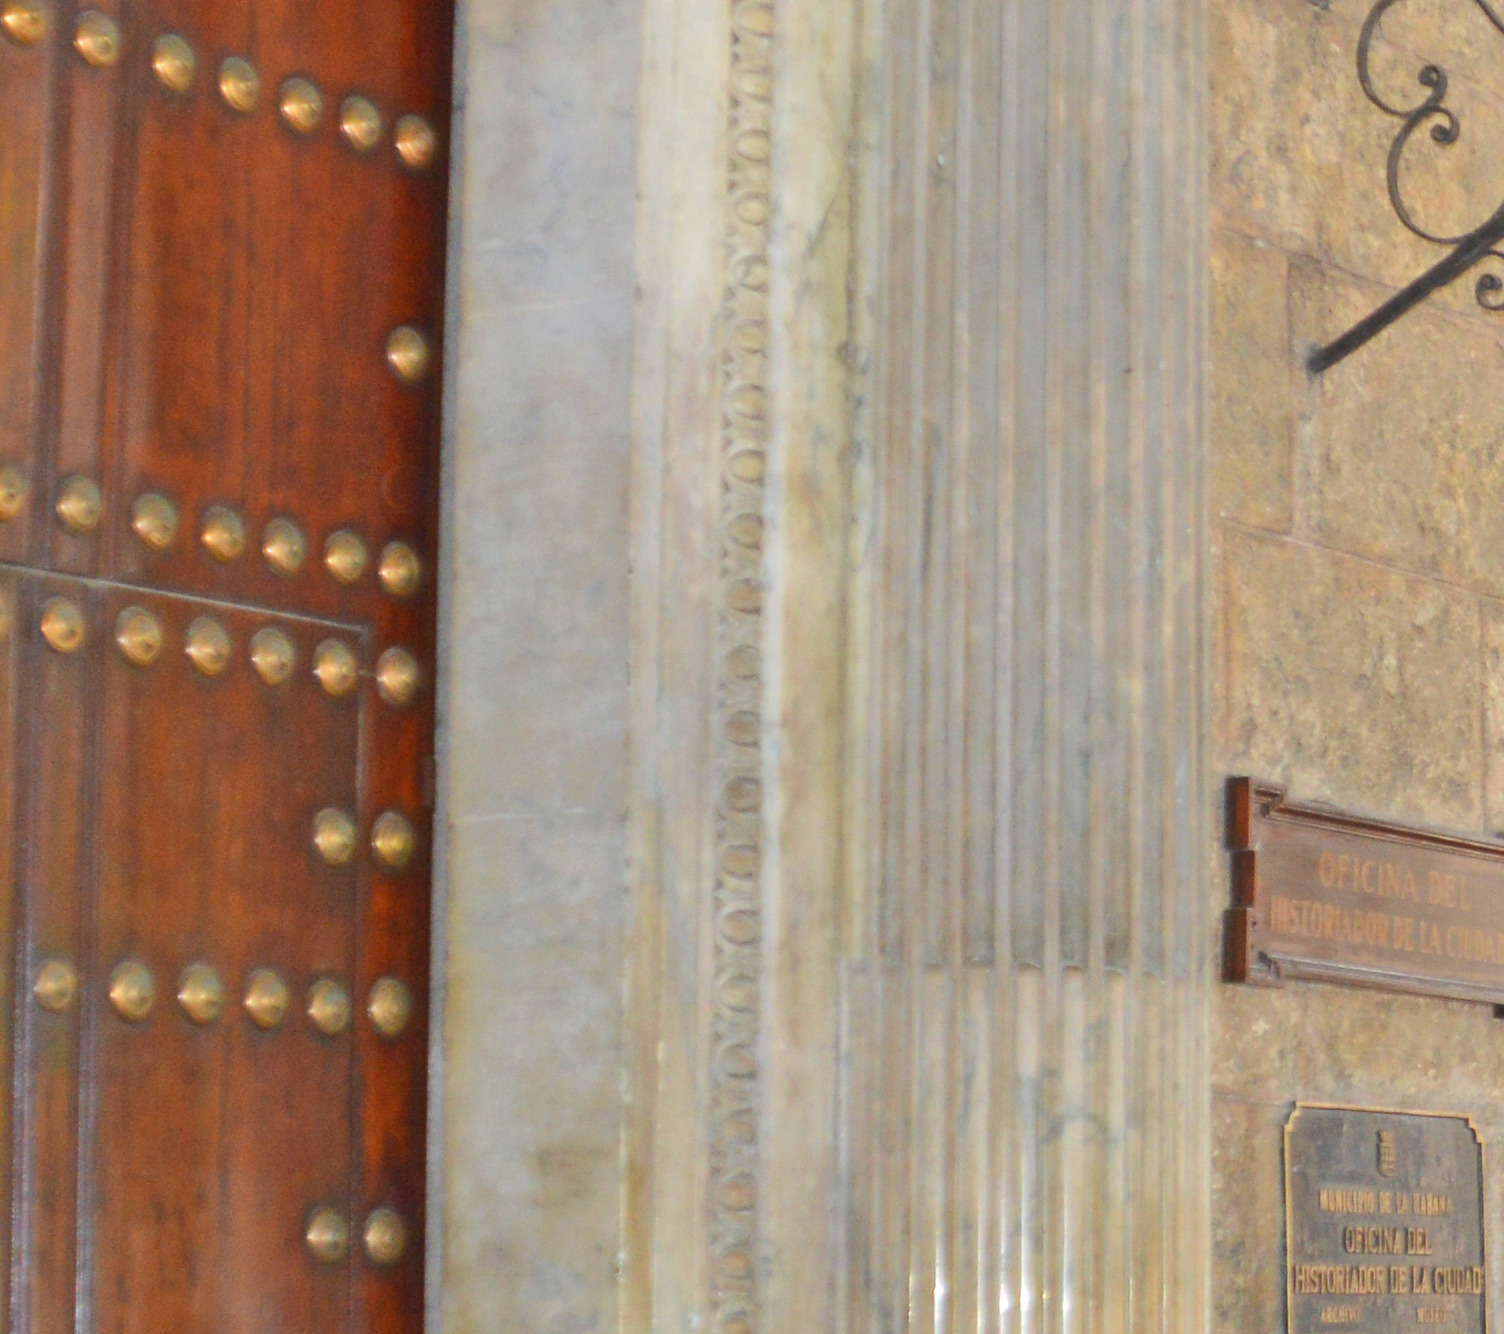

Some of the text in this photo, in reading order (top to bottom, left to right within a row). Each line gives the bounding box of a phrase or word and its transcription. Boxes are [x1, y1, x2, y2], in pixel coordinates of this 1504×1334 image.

[1318, 850, 1472, 911] OFICINA DEL
[1270, 895, 1389, 948] HISTORIADOR
[1393, 915, 1415, 952] DE
[1419, 920, 1442, 955] LA
[1318, 1189, 1375, 1214] MUNICIPIO
[1344, 1226, 1433, 1256] OFICINA DEL
[1295, 1266, 1482, 1295] HISTORIADOR DE LA CIUDAD
